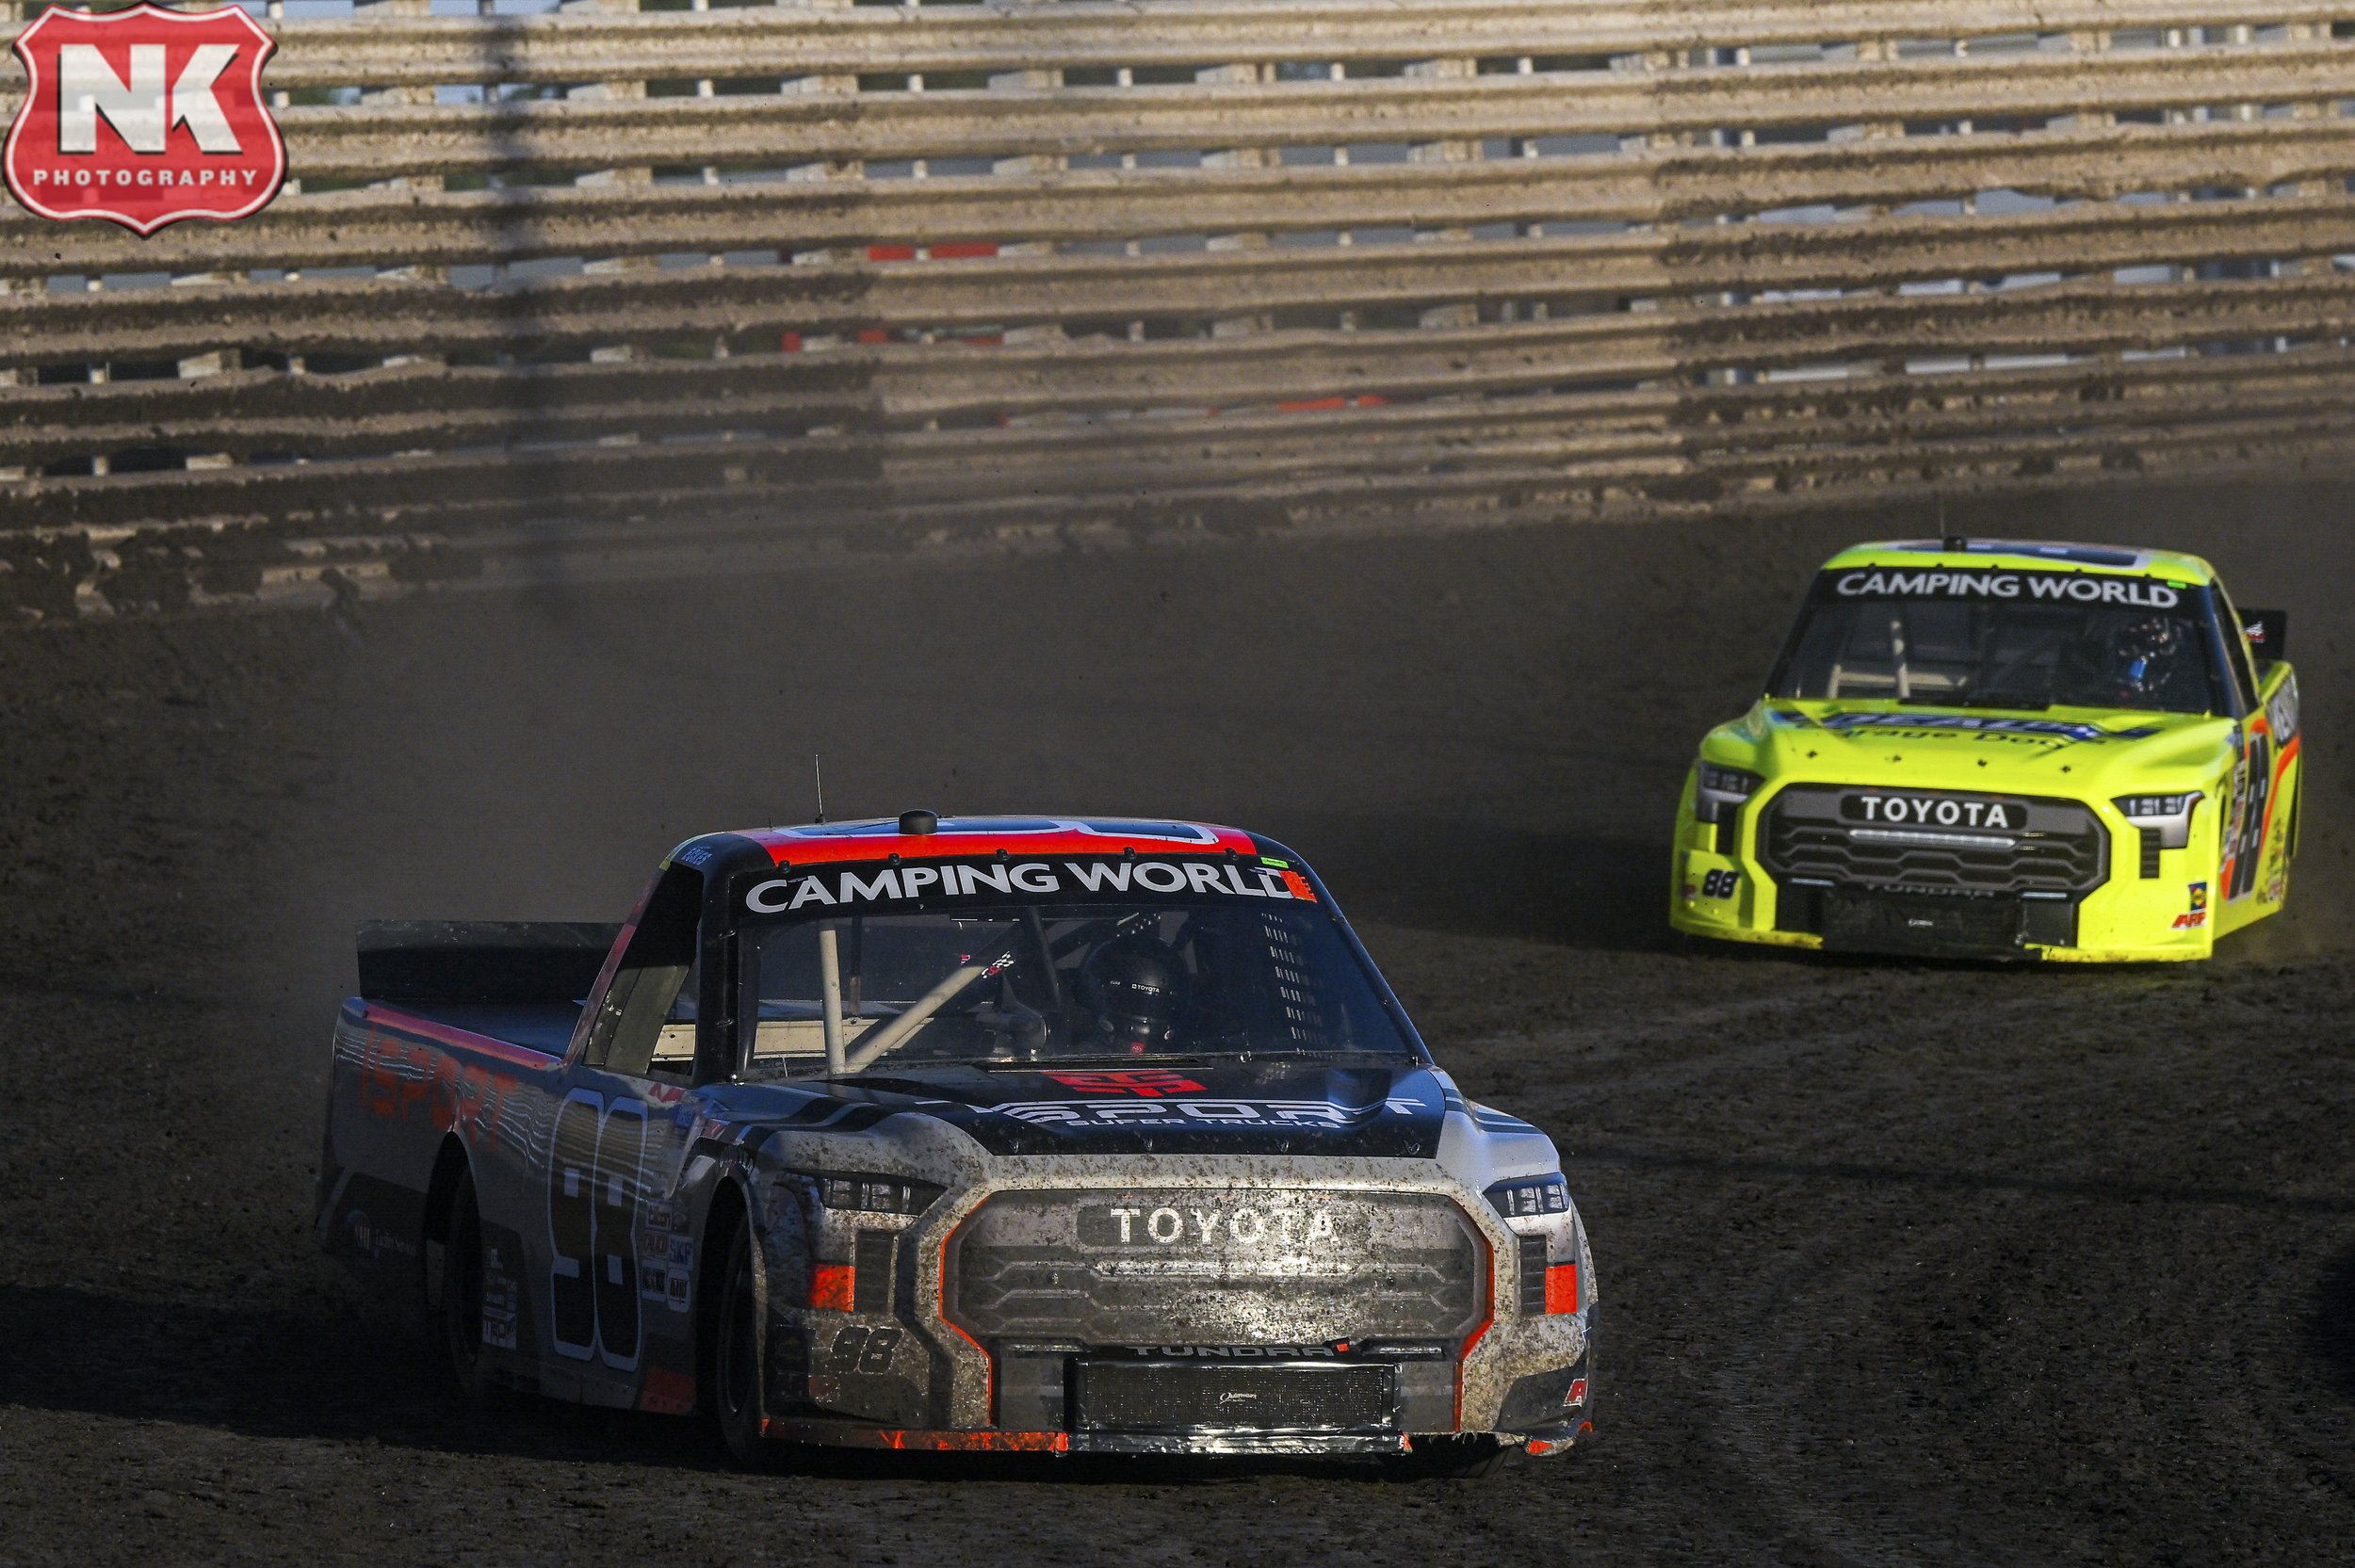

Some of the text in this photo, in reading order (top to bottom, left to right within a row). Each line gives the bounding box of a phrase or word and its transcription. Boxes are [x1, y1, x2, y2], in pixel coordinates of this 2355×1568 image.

[1837, 573, 2178, 608] CAMPING WORLD
[1861, 796, 2008, 829] TOYOTA
[745, 863, 1060, 913] CAMPING
[1702, 868, 1741, 899] 88
[1137, 984, 1160, 993] TOYOTA
[1065, 1118, 1342, 1129] SUPER TRUCKS
[1110, 1207, 1340, 1244] TOYOTA
[1125, 1346, 1336, 1357] TUNDRA
